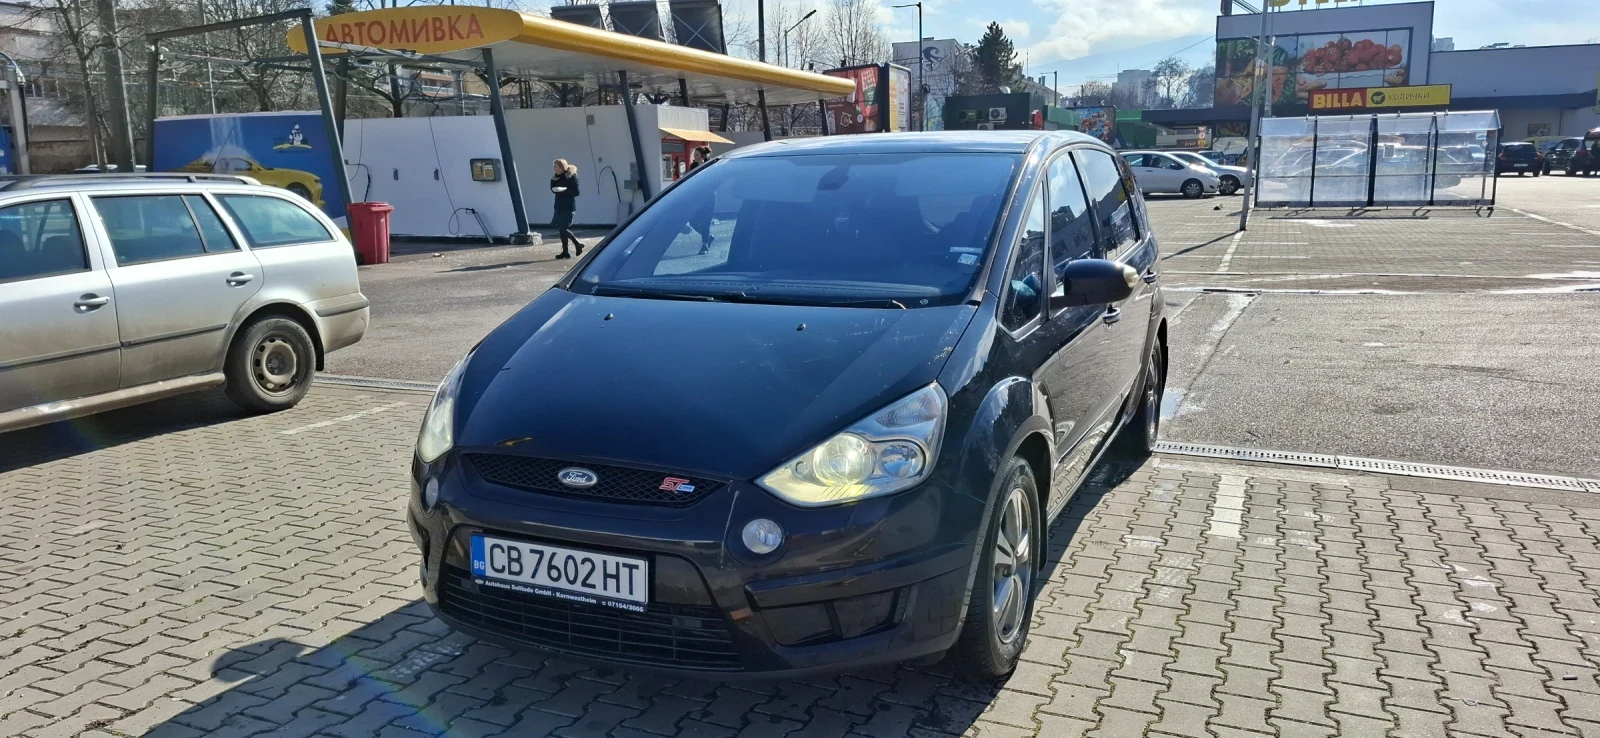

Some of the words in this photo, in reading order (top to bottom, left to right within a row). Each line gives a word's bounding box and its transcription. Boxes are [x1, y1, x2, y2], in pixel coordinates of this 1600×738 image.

[325, 13, 485, 46] АВТОМИВКА
[1312, 92, 1363, 109] BILLA
[566, 471, 588, 483] Ford
[659, 476, 690, 492] ST
[473, 559, 485, 570] BG
[529, 548, 597, 590] 7602
[485, 580, 511, 590] Autohaus
[535, 587, 552, 597] GmbH
